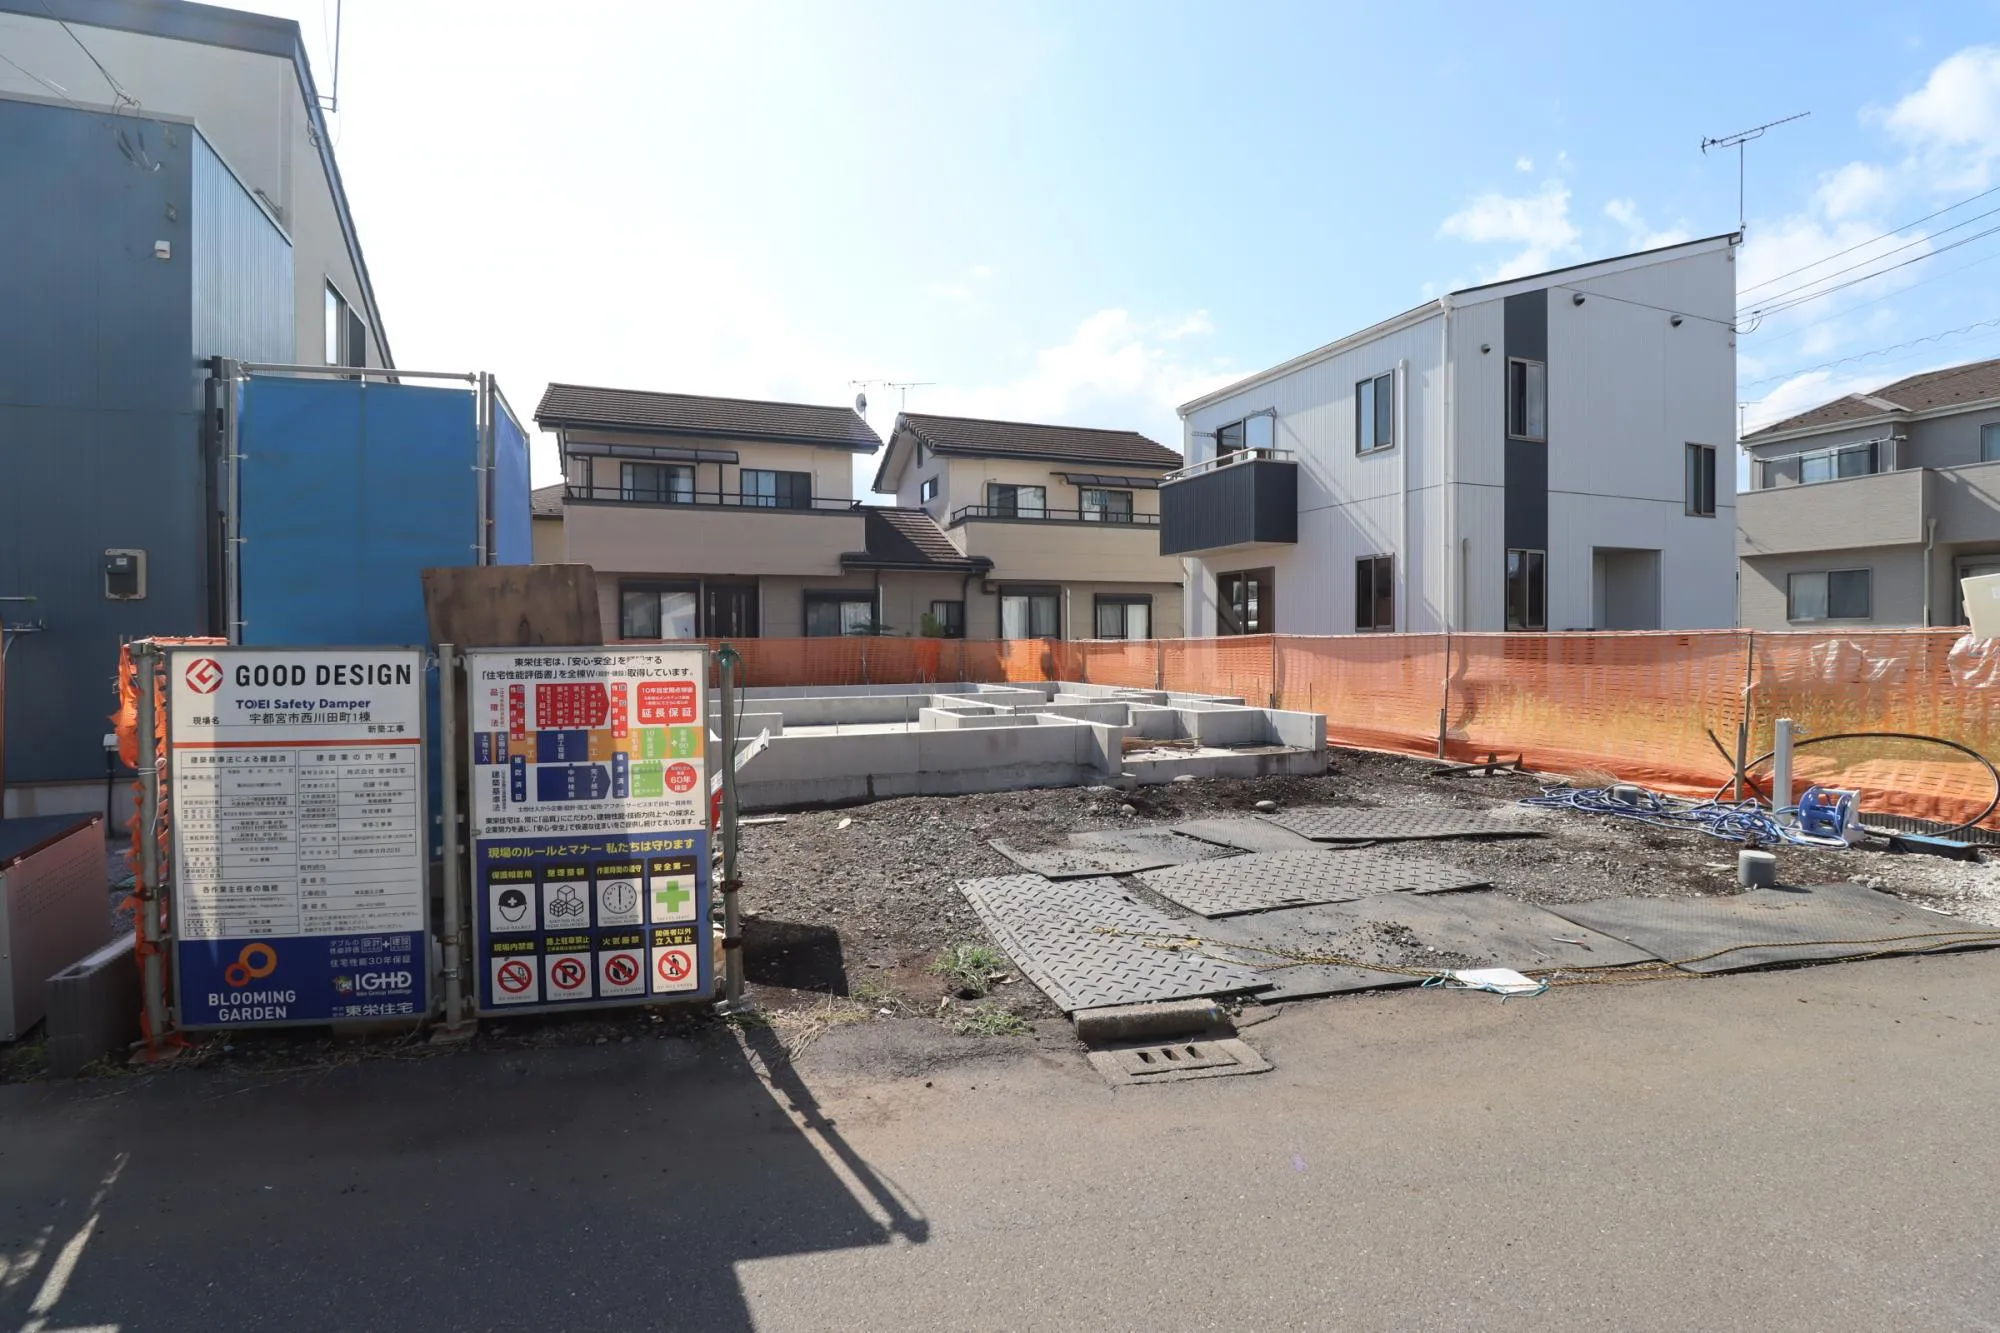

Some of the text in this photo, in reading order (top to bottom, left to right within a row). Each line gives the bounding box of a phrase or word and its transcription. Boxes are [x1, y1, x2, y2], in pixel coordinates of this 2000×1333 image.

[235, 663, 411, 687] GOOD DESIGN
[273, 698, 316, 711] Safety
[319, 698, 371, 710] Damper
[193, 716, 220, 725] 現場名
[249, 711, 371, 725] 宇都宮市西川田町1棟
[670, 775, 692, 784] 60年
[488, 838, 695, 858] 現場のルールとマナー 私たちは守ります
[653, 862, 691, 872] 安全第一
[655, 928, 692, 937] 関係者以外
[655, 935, 693, 946] 立入禁止
[208, 990, 296, 1007] BLOOMING
[218, 1006, 287, 1022] GARDEN
[345, 1002, 414, 1017] 東栄住宅
